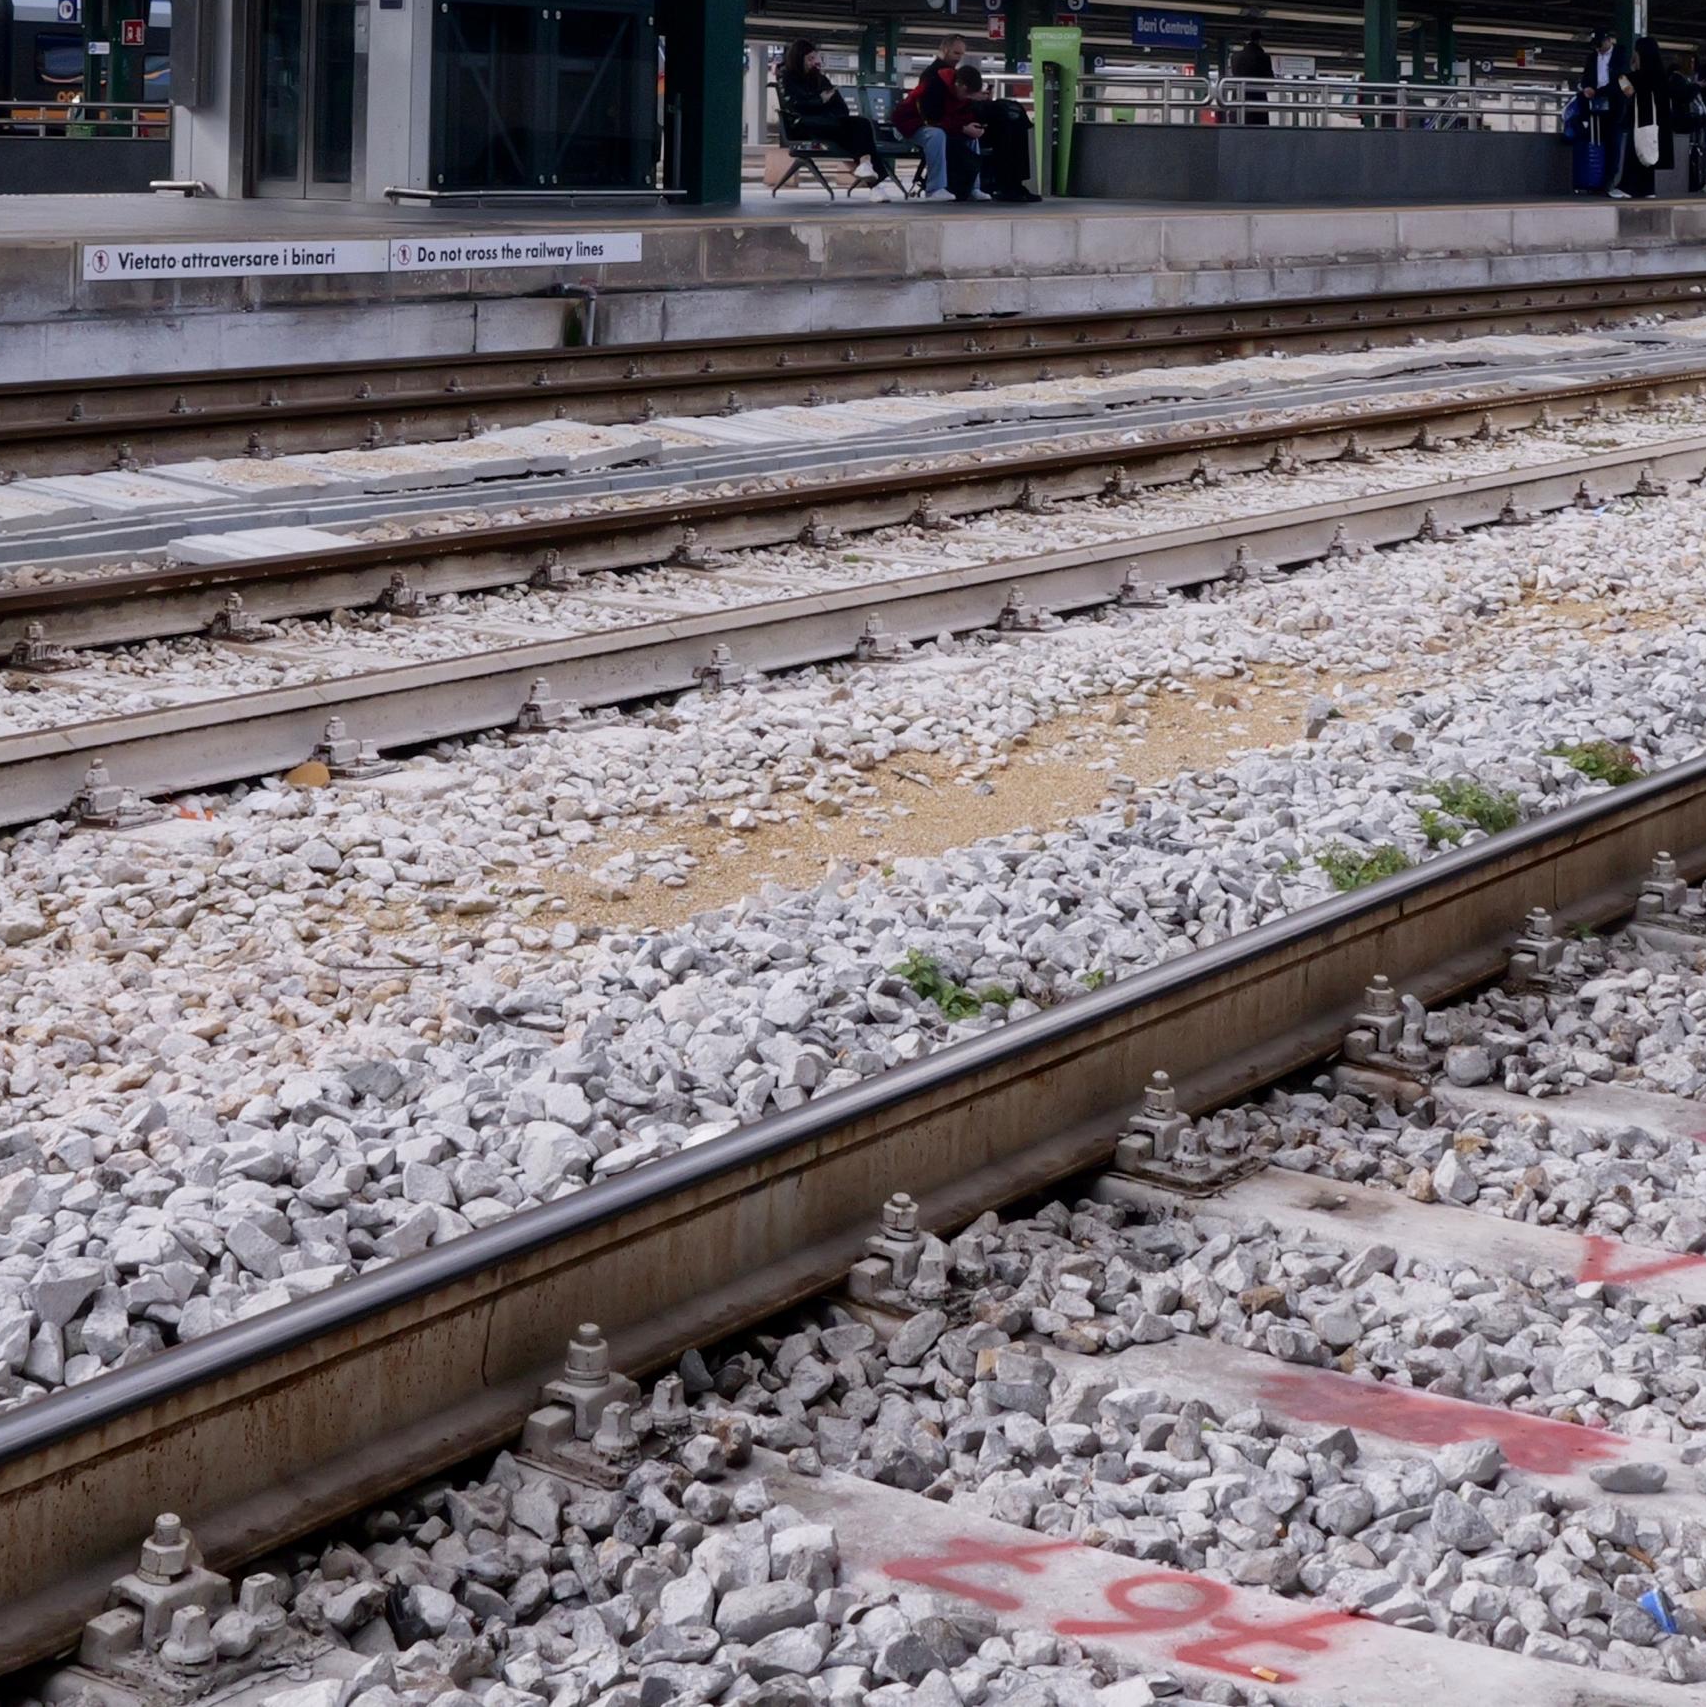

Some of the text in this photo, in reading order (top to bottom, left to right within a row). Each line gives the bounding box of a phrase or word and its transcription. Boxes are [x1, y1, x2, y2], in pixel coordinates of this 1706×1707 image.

[1136, 17, 1199, 36] Bari Centrale
[118, 246, 336, 270] Vietato attraversare i binari
[417, 241, 604, 263] Do not cross the railway lines
